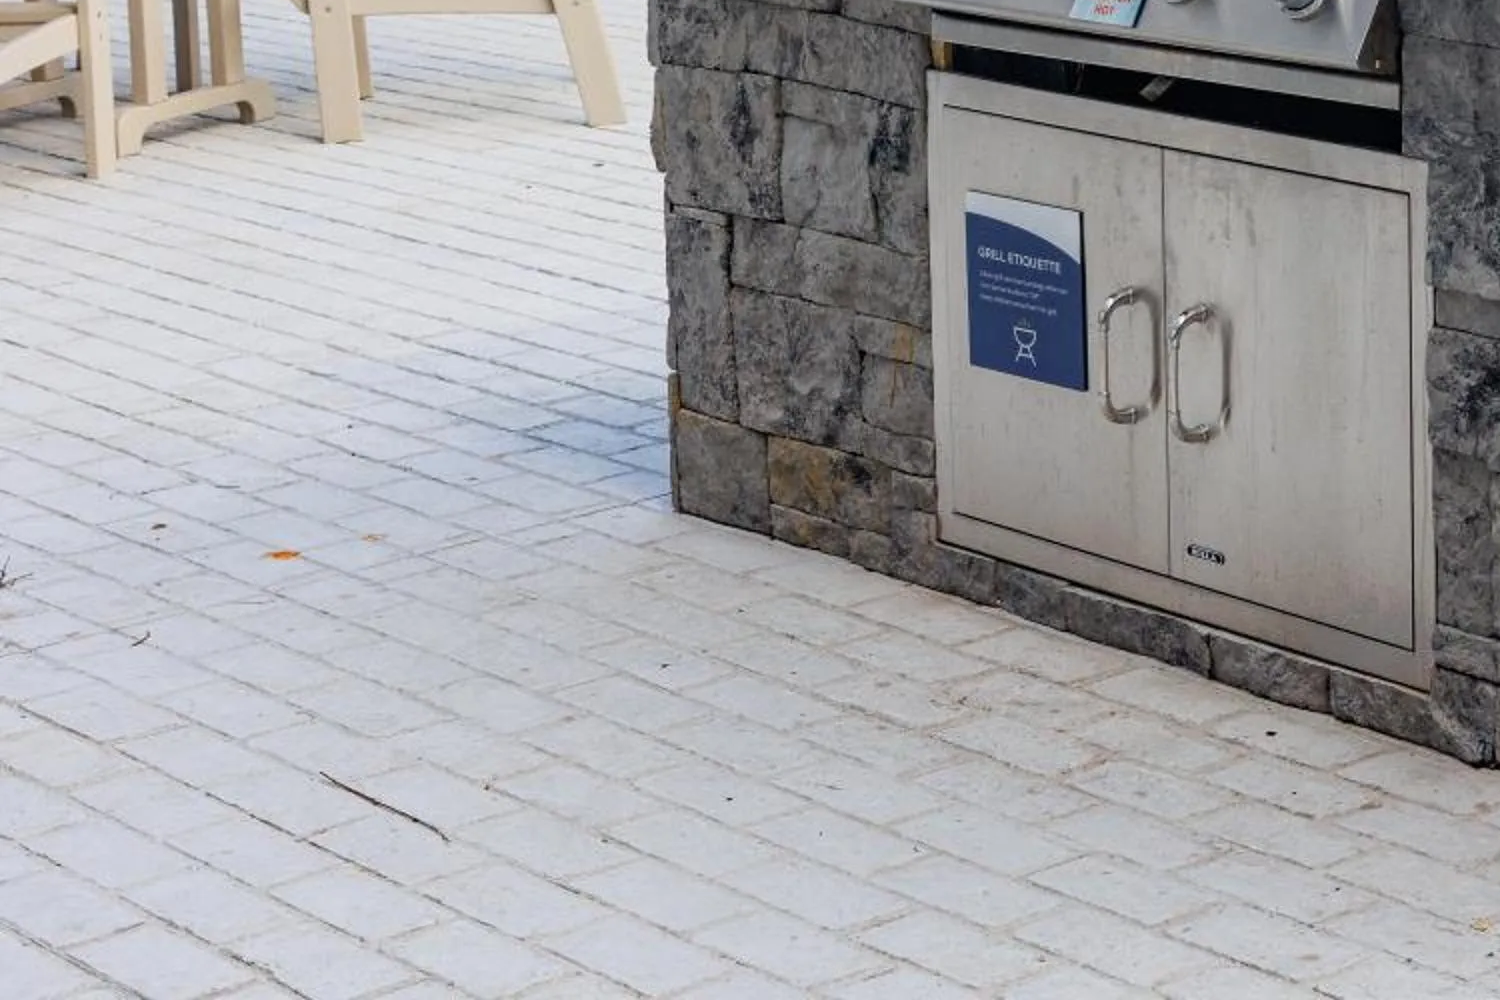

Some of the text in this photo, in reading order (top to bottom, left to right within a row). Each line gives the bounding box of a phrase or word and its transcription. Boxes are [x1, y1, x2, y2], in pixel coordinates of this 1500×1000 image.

[1094, 4, 1116, 16] HOT
[977, 246, 1061, 275] GRILL ETIQUETTE
